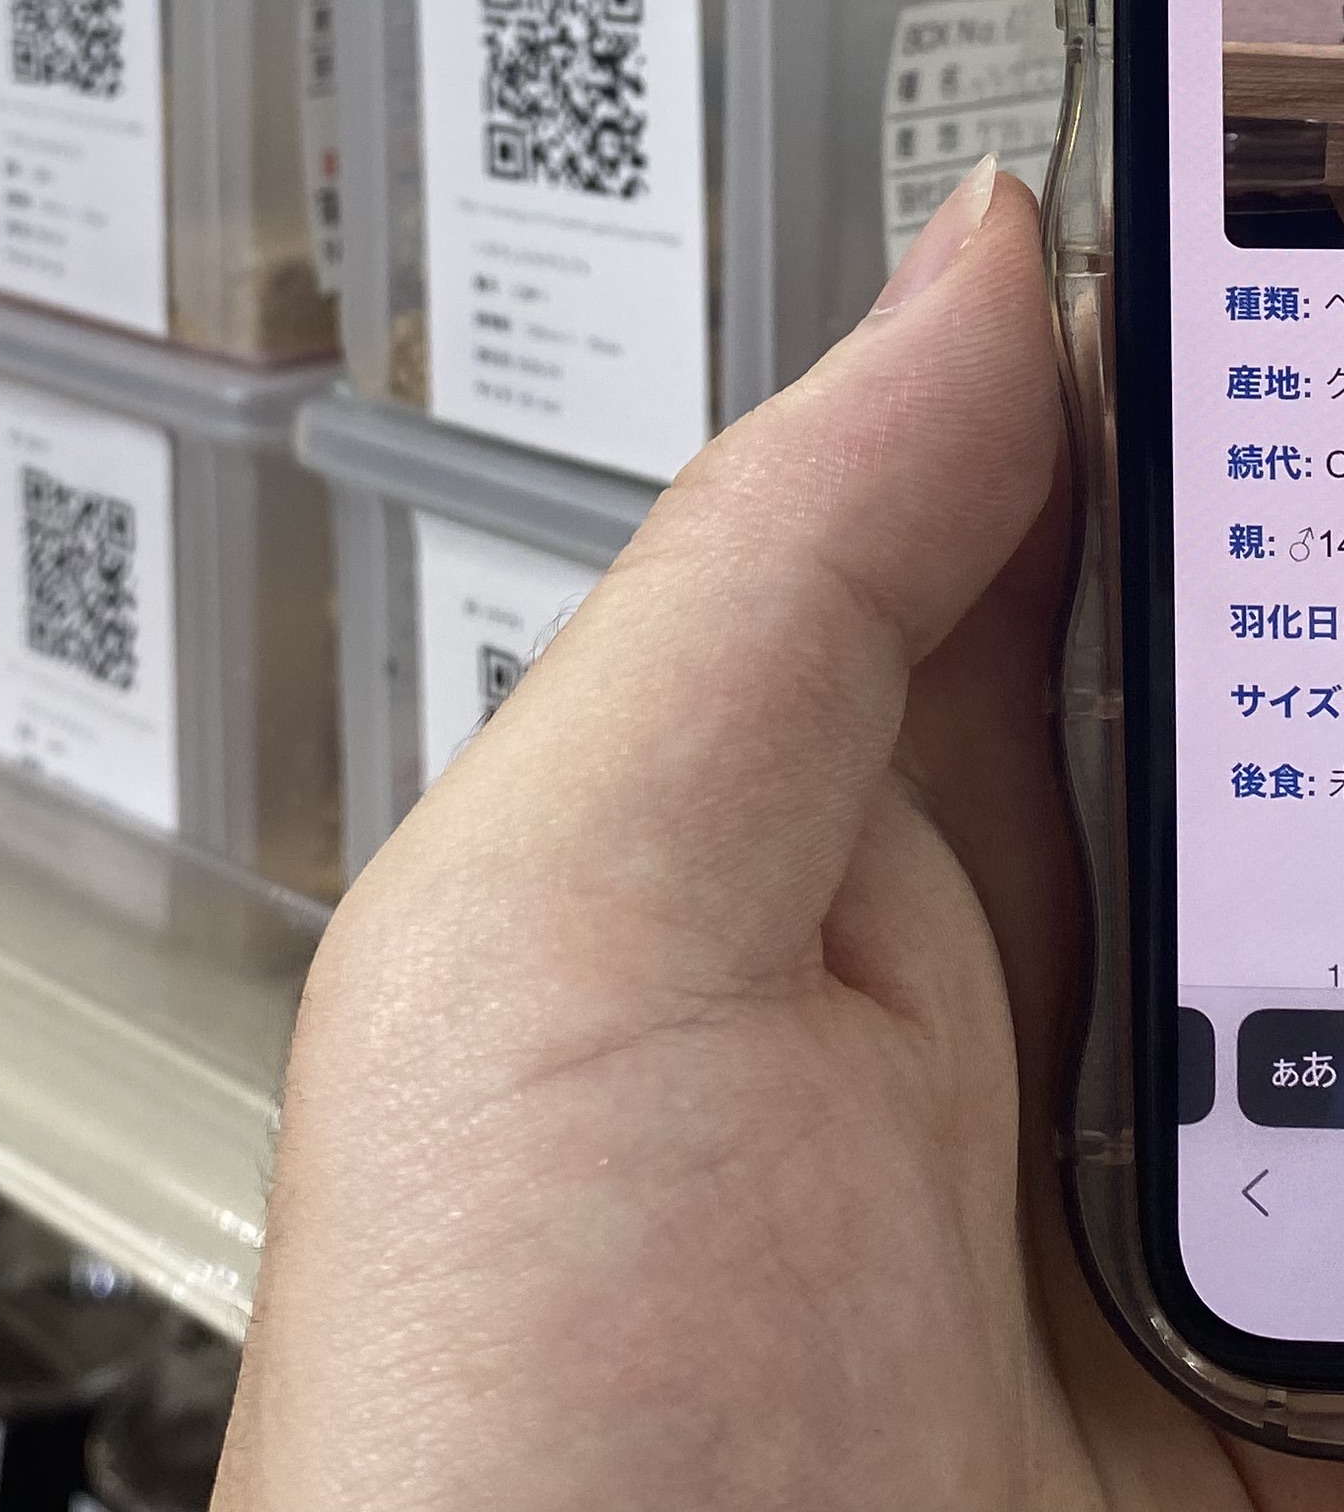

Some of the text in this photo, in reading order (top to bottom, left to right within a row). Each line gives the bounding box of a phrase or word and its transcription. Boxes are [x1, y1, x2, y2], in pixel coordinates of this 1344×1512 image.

[1226, 286, 1309, 321] 種類:
[1227, 365, 1310, 400] 産地:
[1228, 444, 1311, 480] 続代:
[1229, 523, 1275, 559] 親:
[1231, 763, 1315, 799] 後食:
